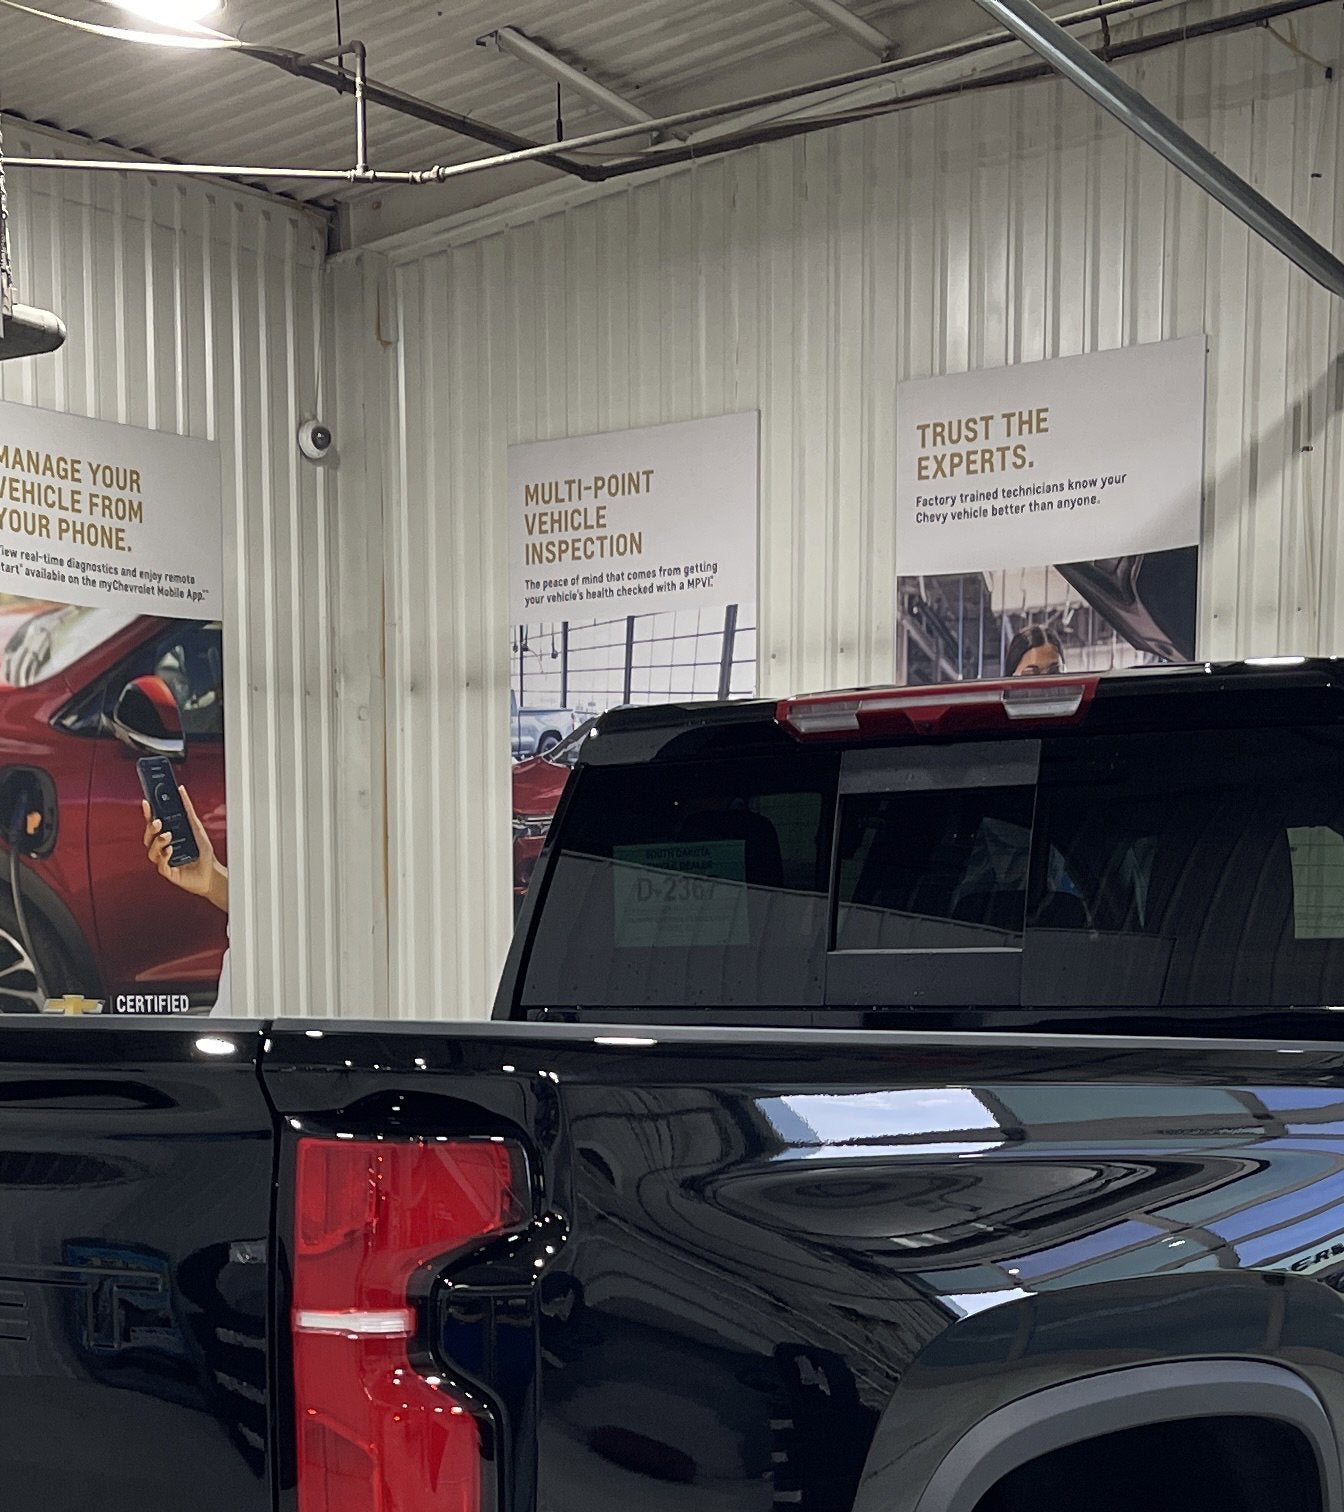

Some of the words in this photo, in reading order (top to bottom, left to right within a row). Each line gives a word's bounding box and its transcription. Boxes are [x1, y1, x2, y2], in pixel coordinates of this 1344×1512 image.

[916, 414, 994, 449] TRUST
[1001, 407, 1049, 438] THE
[87, 461, 141, 494] YOUR
[917, 444, 1034, 481] EXPERTS.
[524, 469, 654, 507] MULTI-POINT
[916, 493, 957, 508] Factory
[960, 488, 999, 504] trained
[1001, 481, 1065, 500] technicians
[1067, 477, 1098, 491] know
[1100, 473, 1127, 489] your
[89, 493, 143, 523] FROM
[524, 505, 607, 536] VEHICLE
[916, 509, 948, 525] Chevy
[950, 504, 989, 520] vehicle
[991, 501, 1026, 517] better
[1028, 499, 1054, 512] than
[1057, 495, 1101, 511] anyone.
[58, 517, 132, 552] PHONE.
[525, 531, 642, 566] INSPECTION
[20, 549, 64, 567] real-time
[67, 556, 119, 577] diagnostics
[121, 565, 137, 578] and
[139, 568, 162, 584] enjoy
[164, 573, 195, 585] remote
[25, 567, 66, 583] available
[68, 575, 80, 585] on
[82, 575, 97, 588] the
[99, 579, 155, 597] myChevrolet
[157, 586, 185, 599] Mobile
[525, 578, 541, 591] The
[543, 576, 569, 591] peace
[571, 575, 580, 586] of
[582, 572, 604, 585] mind
[606, 571, 625, 583] that
[627, 569, 656, 581] comes
[659, 566, 682, 578] from
[684, 562, 718, 577] getting
[524, 594, 544, 608] your
[547, 590, 584, 603] vehicle's
[586, 586, 614, 600] health
[616, 584, 654, 598] checked
[656, 581, 677, 593] with
[679, 581, 685, 591] a
[116, 994, 190, 1013] CERTIFIED
